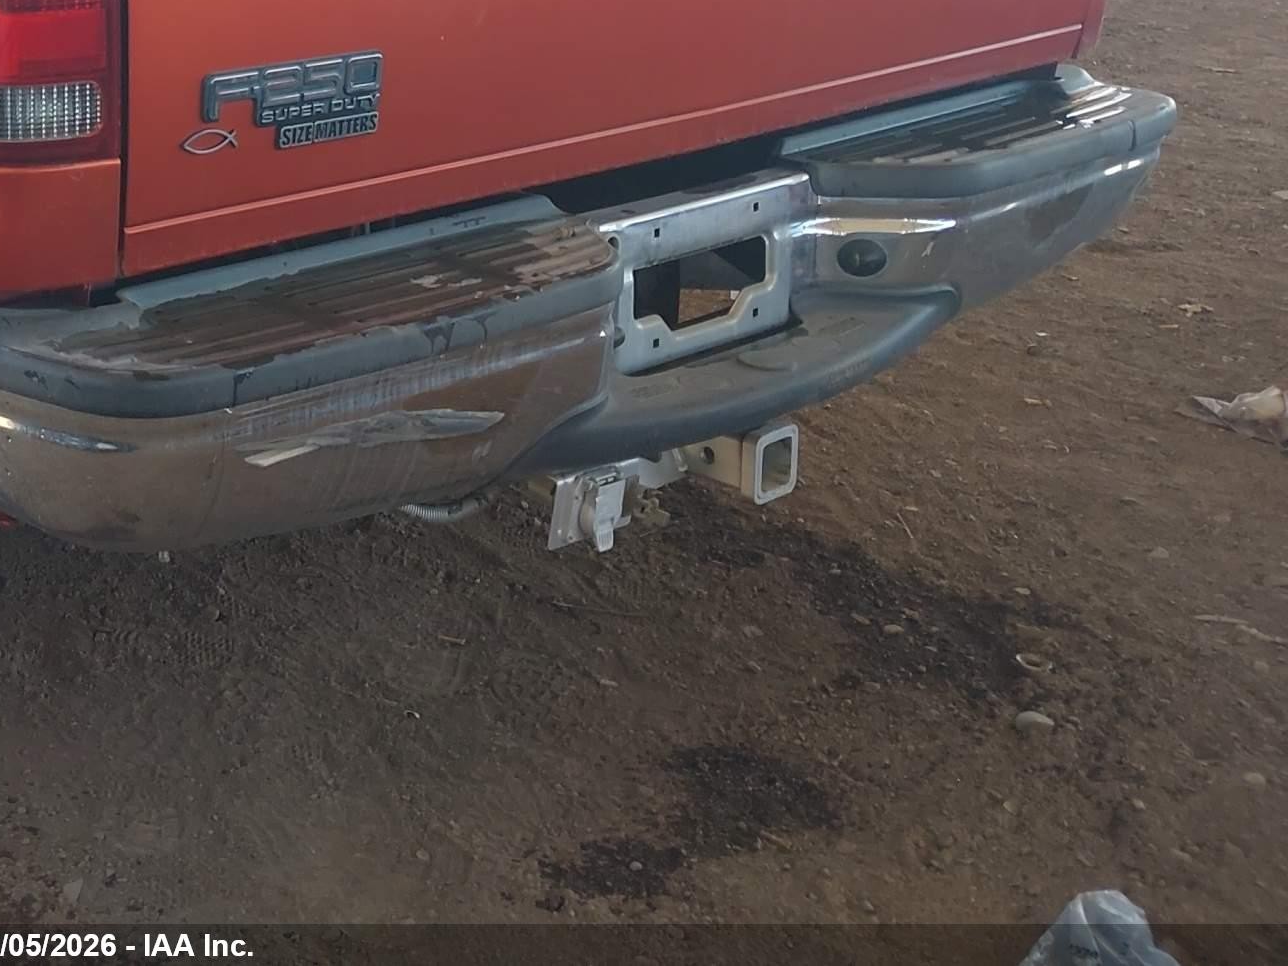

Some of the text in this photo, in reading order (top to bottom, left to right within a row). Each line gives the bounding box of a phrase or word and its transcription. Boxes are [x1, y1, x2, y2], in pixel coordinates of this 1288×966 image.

[261, 93, 380, 123] SUPER DUTY
[281, 113, 378, 146] SIZE MATTERS
